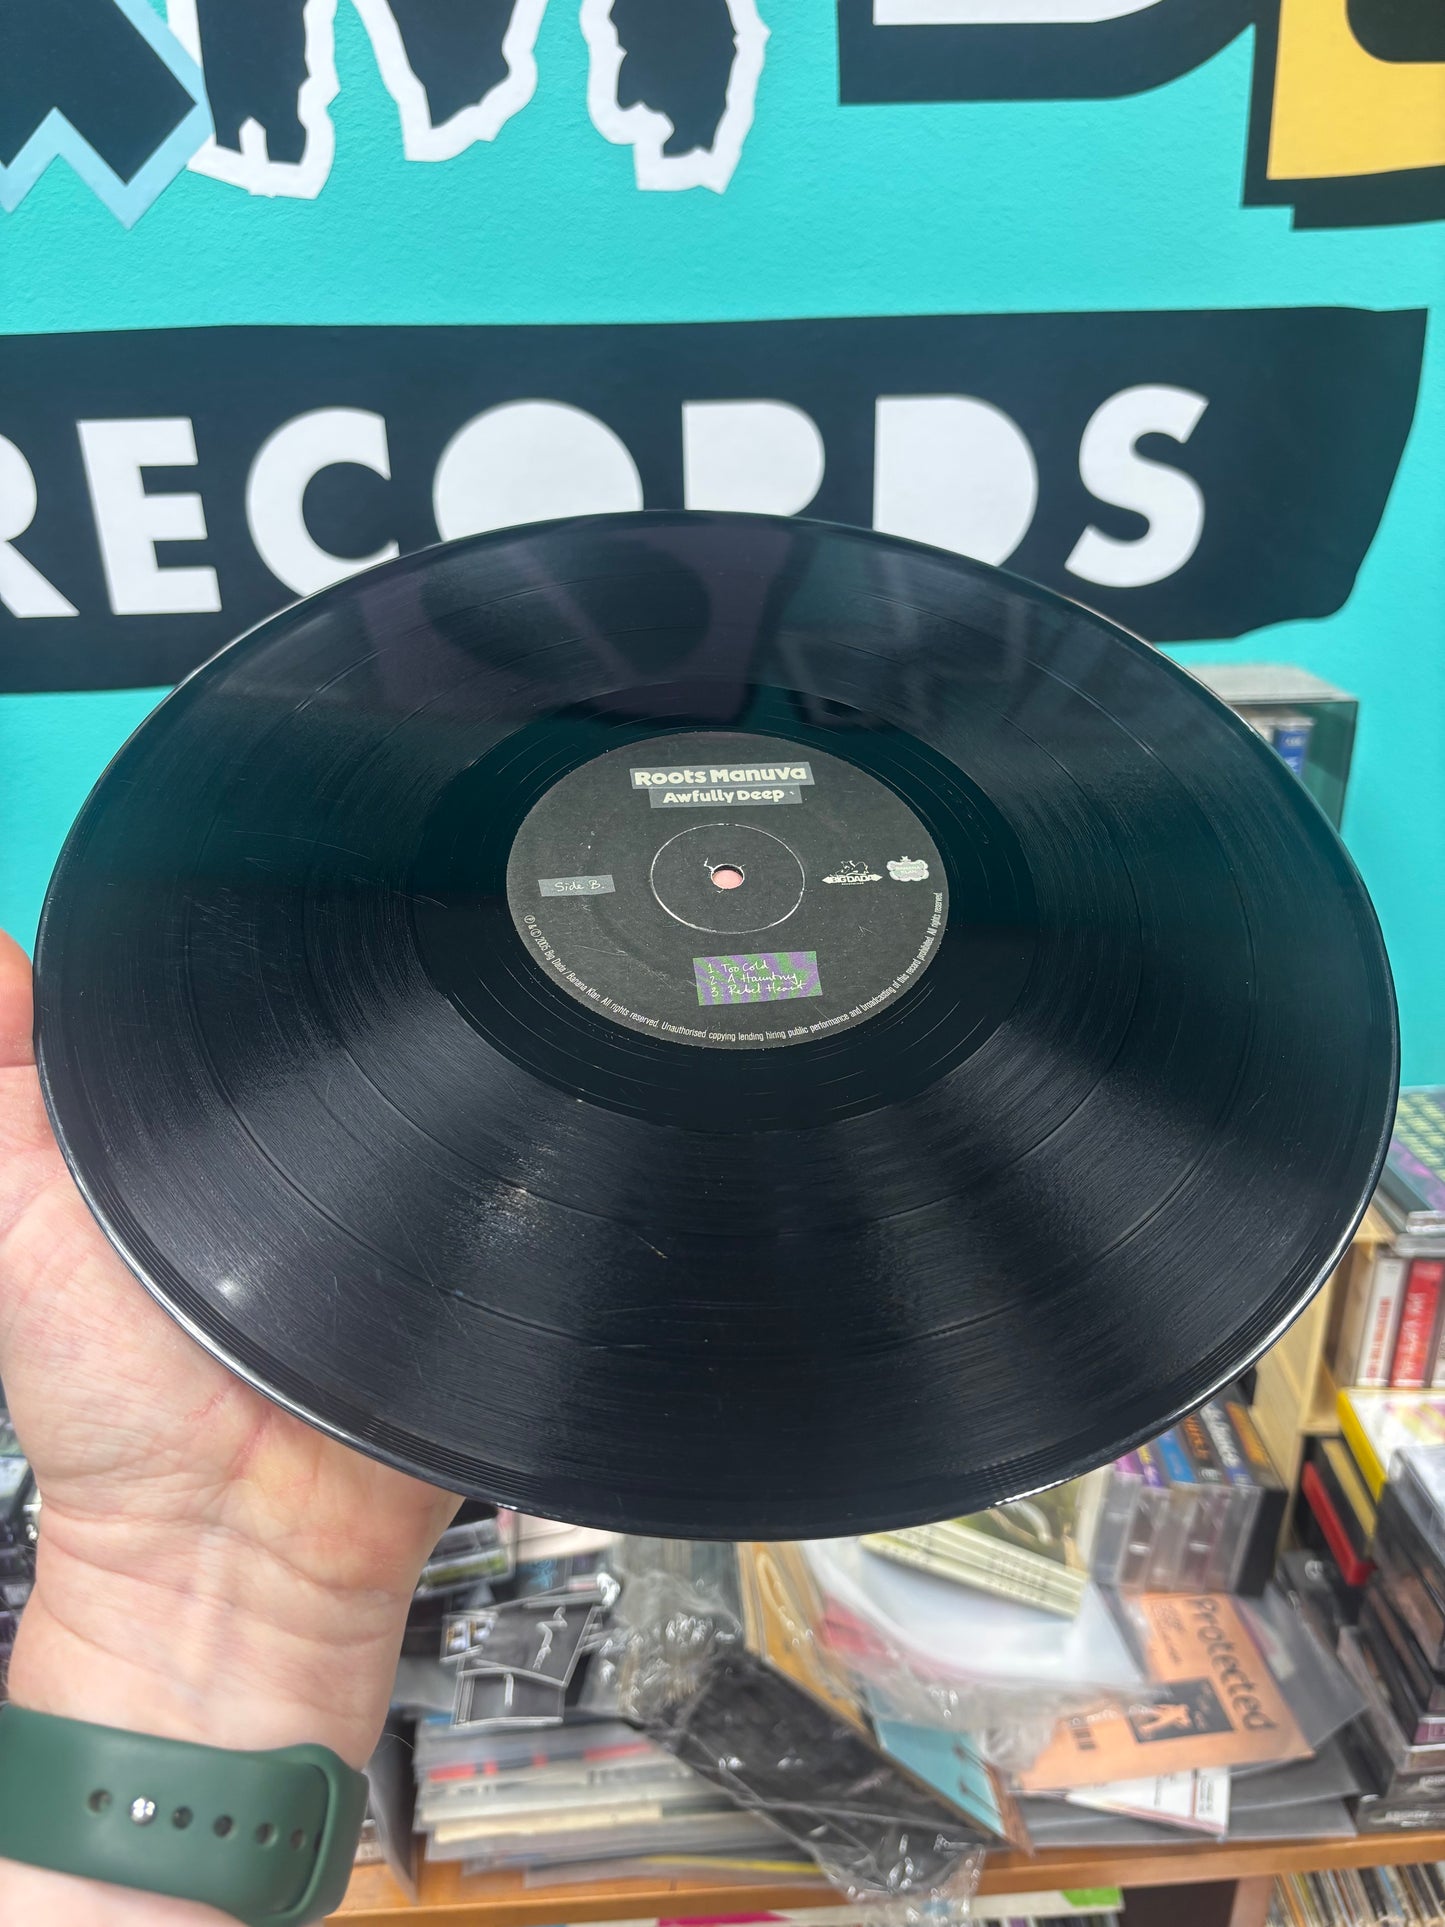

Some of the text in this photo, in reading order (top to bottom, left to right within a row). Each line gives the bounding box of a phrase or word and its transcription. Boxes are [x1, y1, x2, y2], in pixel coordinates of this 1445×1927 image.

[634, 766, 807, 787] Roots Manuva
[662, 789, 785, 804] Awfully Deep
[554, 879, 605, 892] Side B.
[931, 913, 942, 928] rights
[926, 927, 938, 936] All
[535, 936, 551, 952] 2005
[544, 949, 556, 961] Big
[552, 957, 567, 973] Dada
[721, 965, 740, 973] Too
[742, 960, 769, 973] Cold
[906, 958, 922, 975] record
[566, 972, 588, 992] Banana
[727, 975, 736, 984] A
[892, 978, 902, 989] of
[897, 972, 910, 984] this
[728, 984, 761, 994] Rebel
[766, 981, 807, 993] Heart
[601, 997, 612, 1006] All
[861, 985, 897, 1011] broadcasting
[611, 1000, 630, 1017] rights
[849, 1006, 862, 1018] and
[629, 1011, 660, 1028] reserved.
[809, 1013, 850, 1034] performance
[661, 1021, 707, 1039] Unauthorised
[708, 1031, 736, 1042] copying
[766, 1030, 786, 1041] hiring
[788, 1026, 809, 1038] public
[738, 1032, 764, 1042] lending
[1193, 1598, 1280, 1732] Protected
